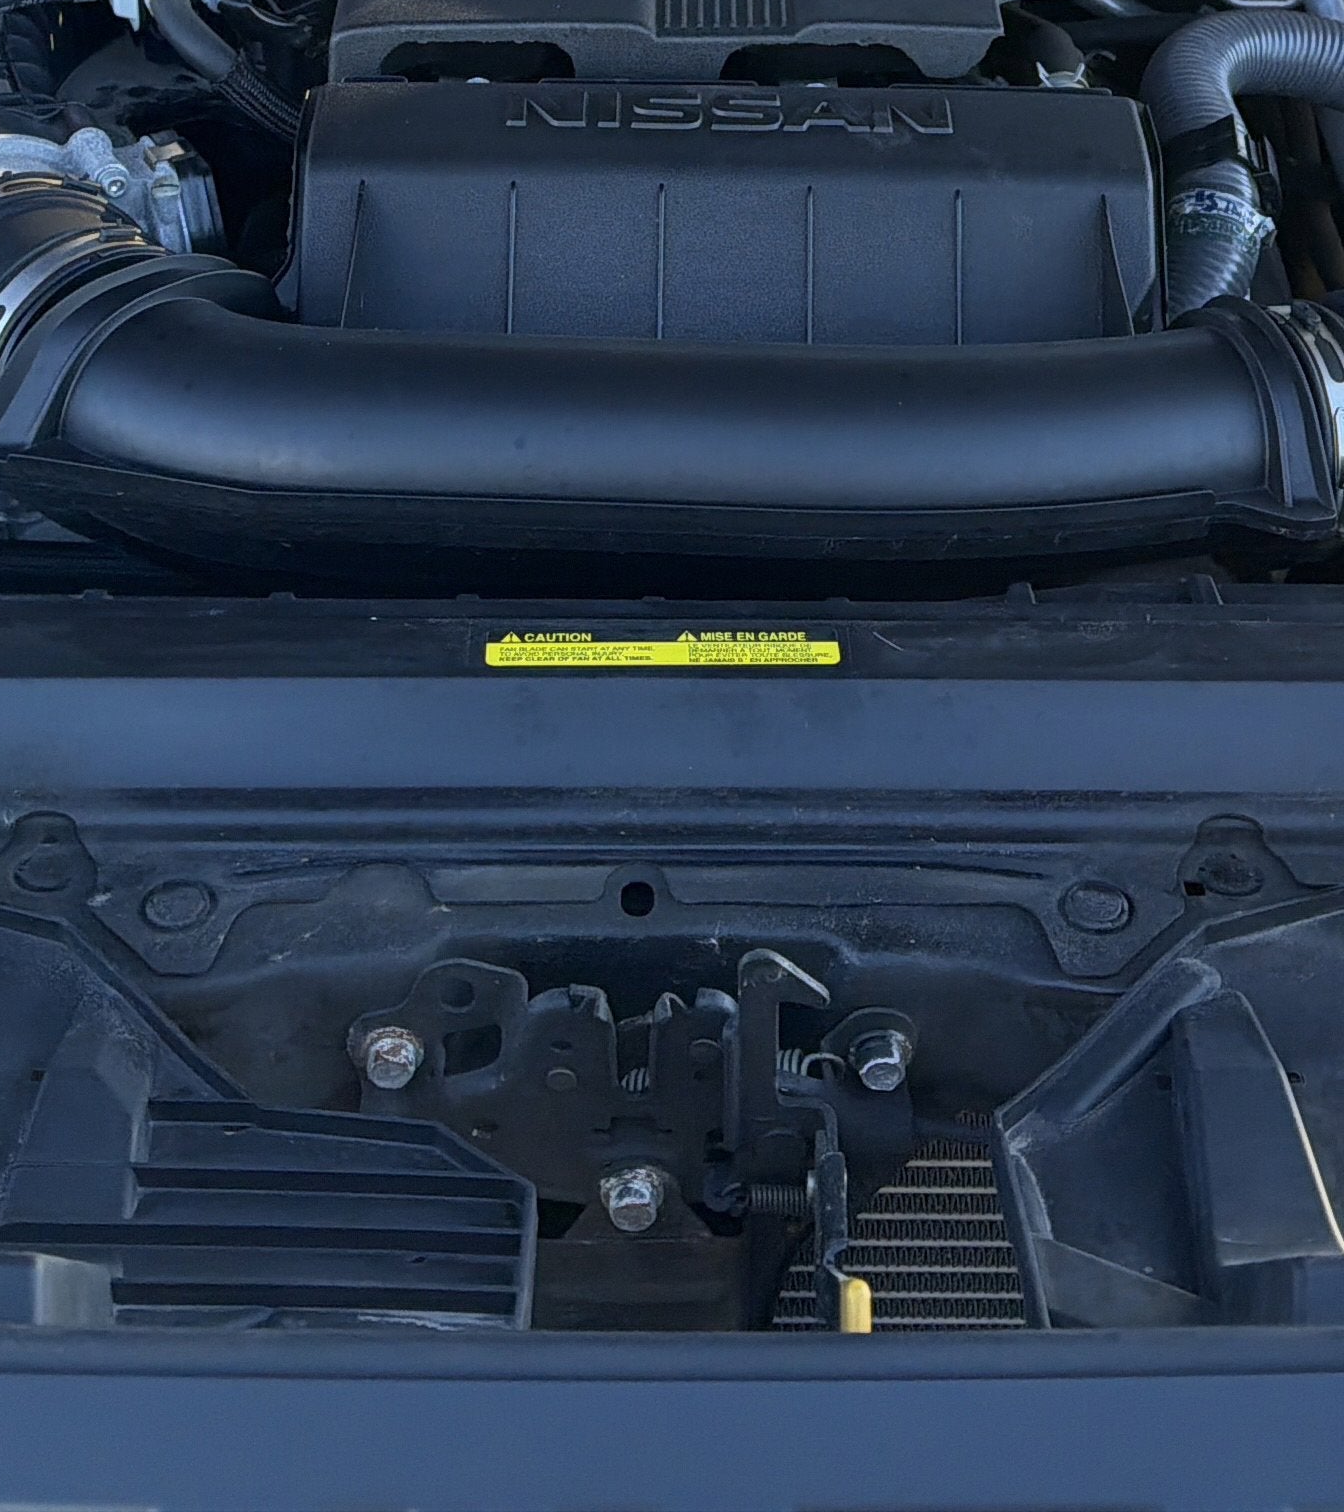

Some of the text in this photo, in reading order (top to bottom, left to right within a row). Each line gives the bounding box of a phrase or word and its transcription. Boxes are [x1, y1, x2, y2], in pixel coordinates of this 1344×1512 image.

[503, 88, 954, 136] NISSAN
[524, 632, 592, 642] CAUTION
[700, 631, 807, 641] MISE EN GARDE
